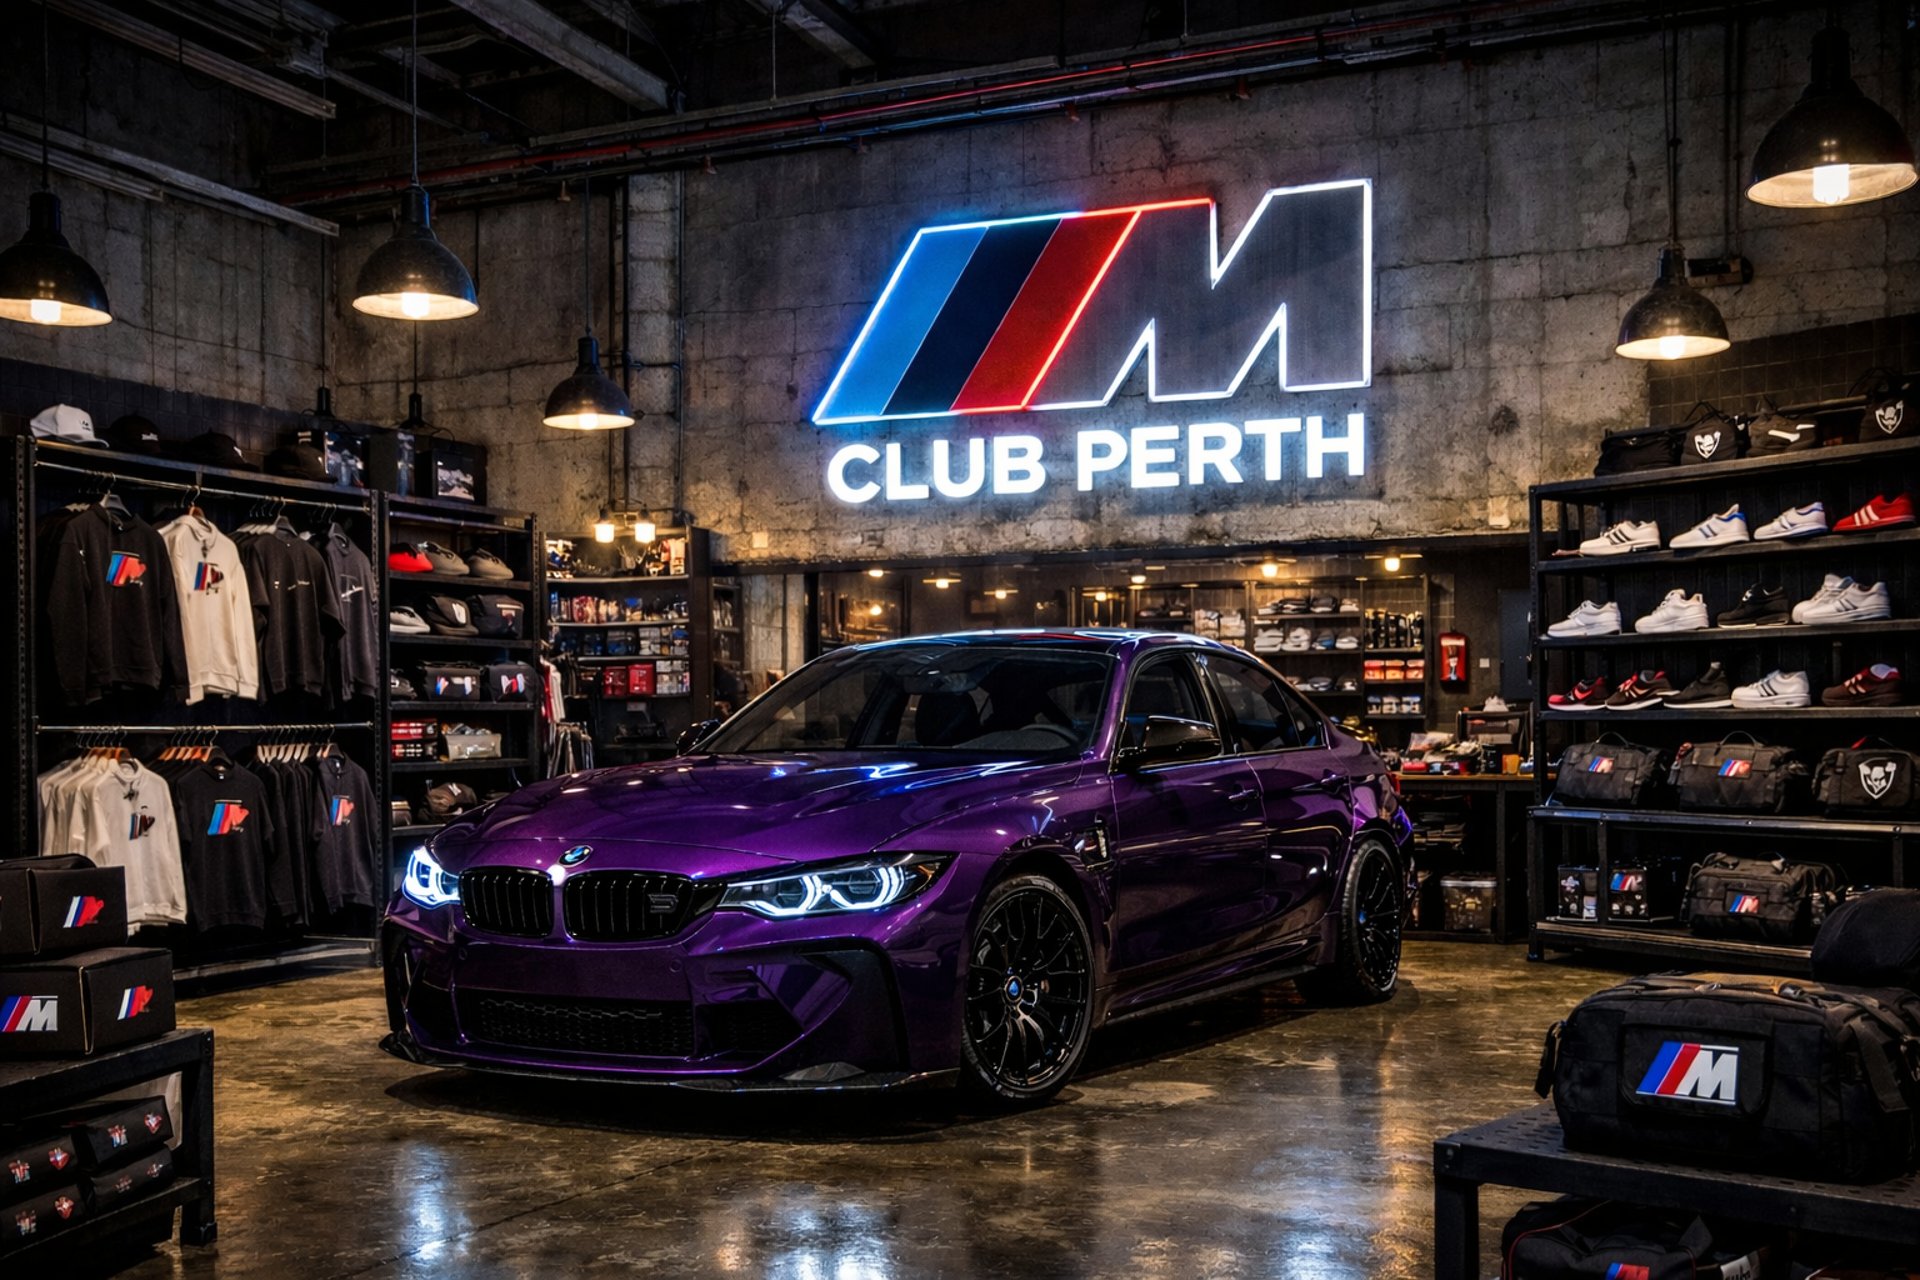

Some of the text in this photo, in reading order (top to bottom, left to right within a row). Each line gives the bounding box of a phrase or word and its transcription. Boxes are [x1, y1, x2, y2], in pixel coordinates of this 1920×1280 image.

[1022, 178, 1373, 409] M
[827, 412, 1365, 504] CLUB PERTH
[15, 999, 58, 1031] M
[1674, 1049, 1738, 1101] M
